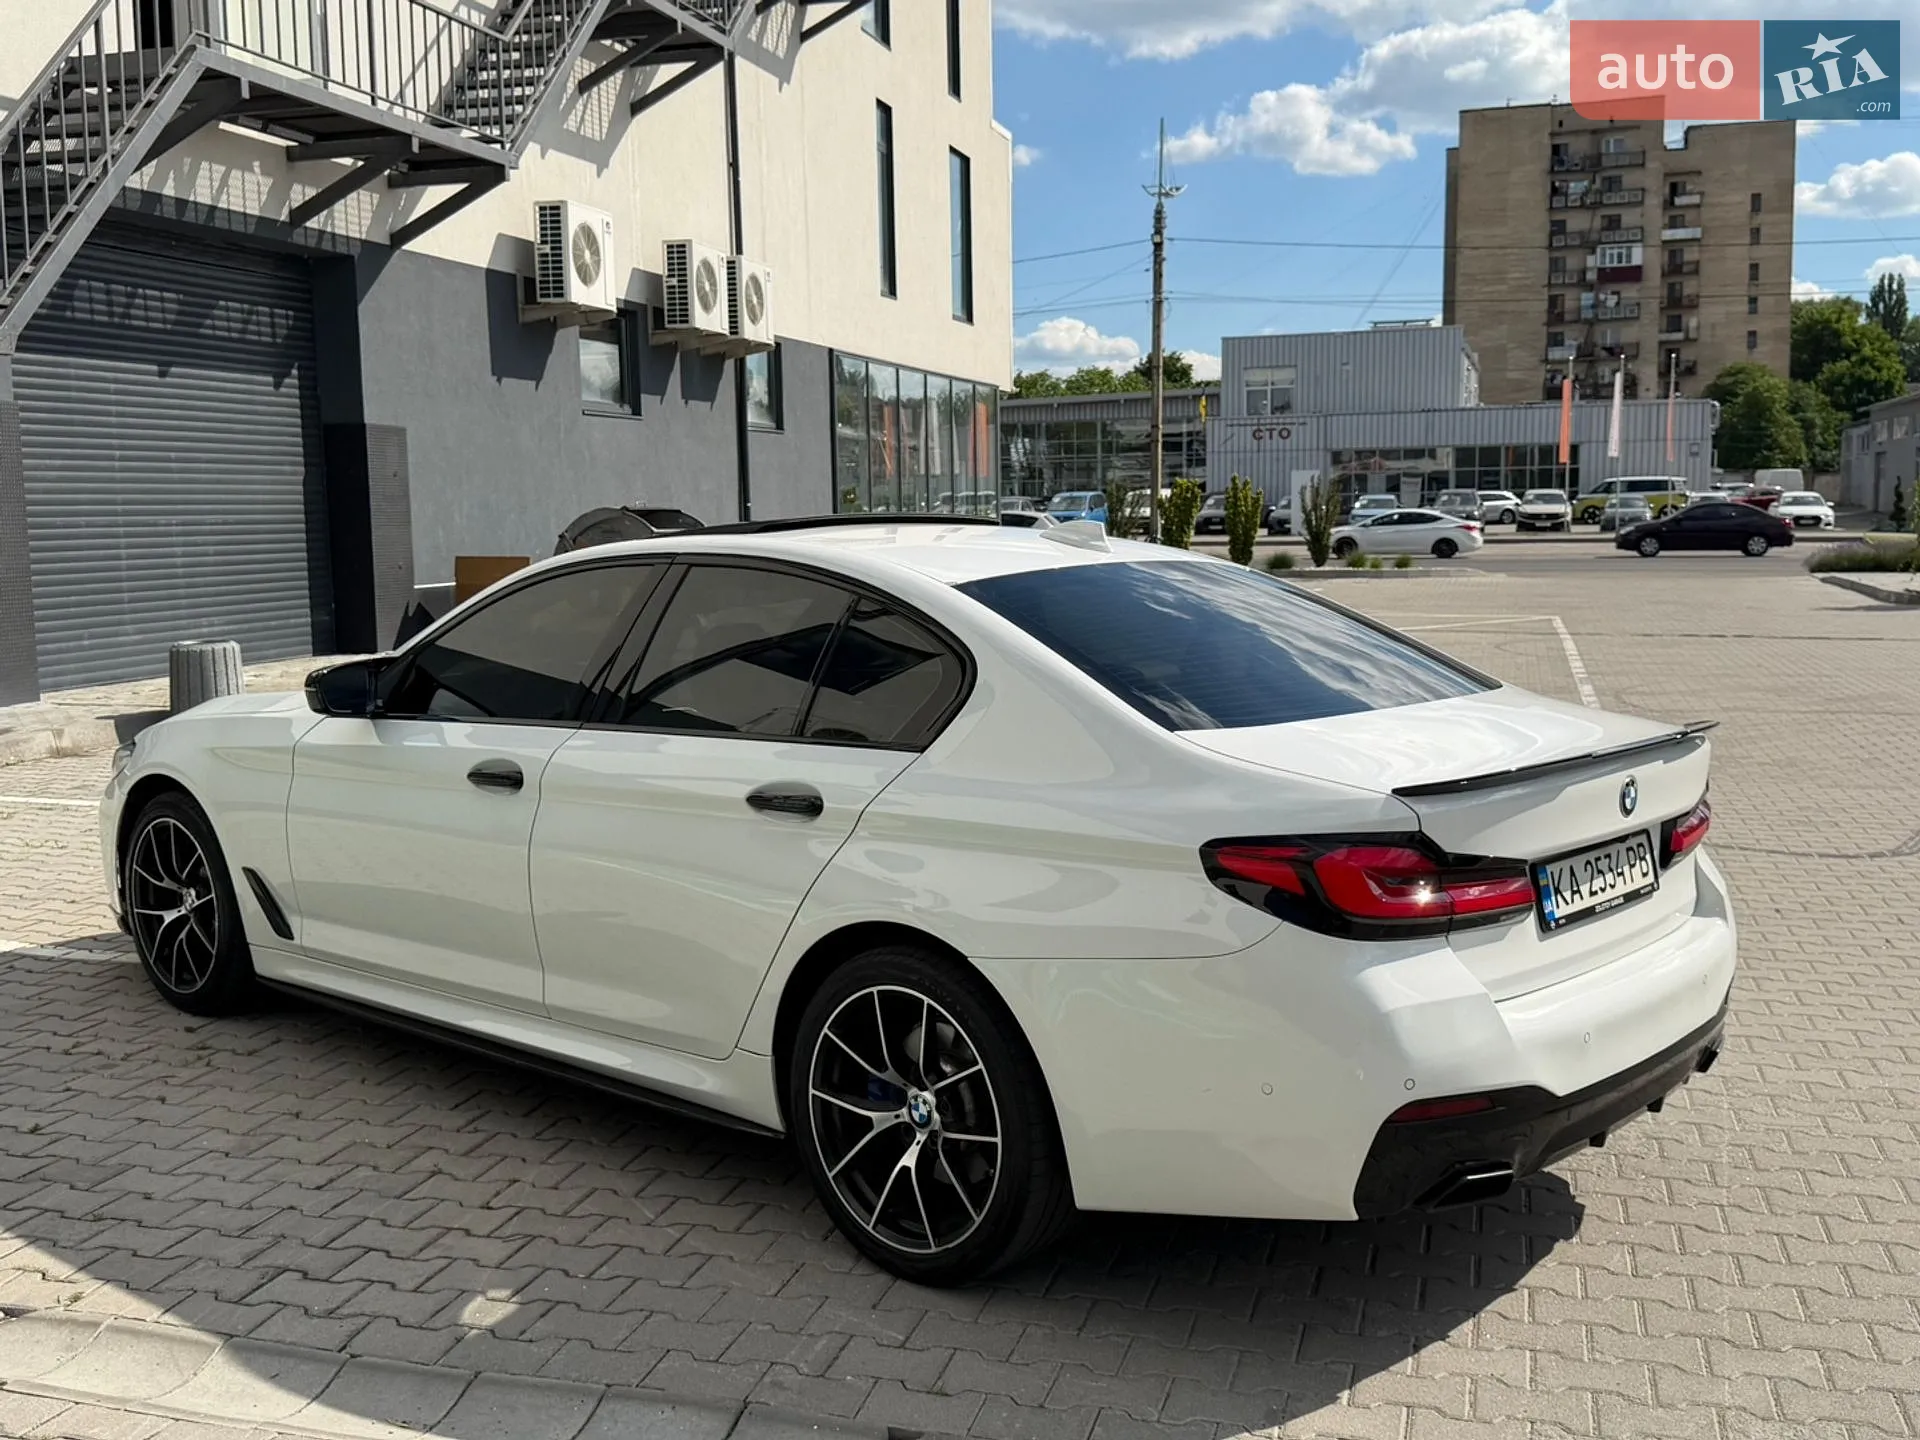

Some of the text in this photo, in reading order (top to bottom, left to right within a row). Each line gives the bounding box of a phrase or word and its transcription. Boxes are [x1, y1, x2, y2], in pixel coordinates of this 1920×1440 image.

[1550, 841, 1649, 909] KA 2534 PB
